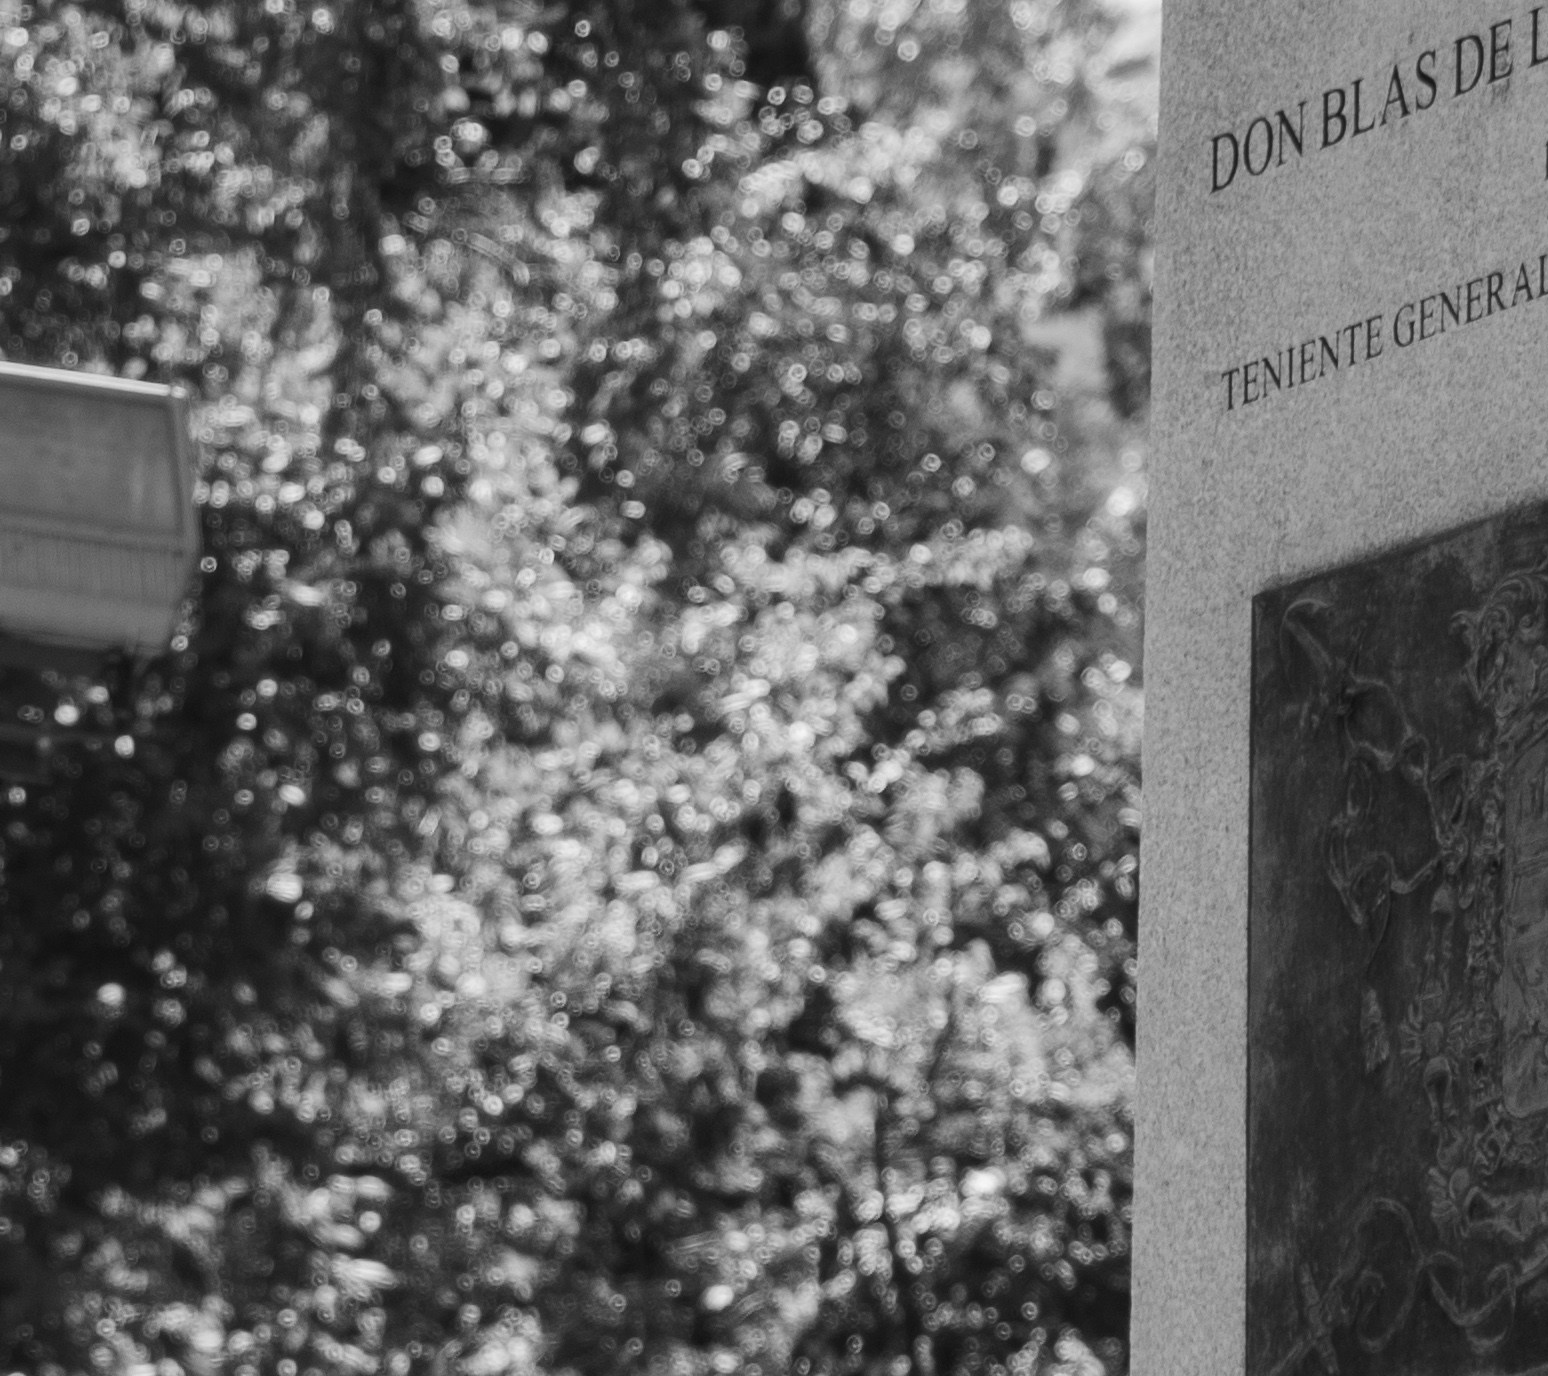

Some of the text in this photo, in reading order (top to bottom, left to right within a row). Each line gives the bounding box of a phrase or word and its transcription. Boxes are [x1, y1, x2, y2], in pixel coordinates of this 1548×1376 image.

[1210, 100, 1307, 194] DON
[1320, 49, 1438, 150] BLAS
[1454, 18, 1514, 97] DE
[1220, 314, 1383, 411] TENIENTE
